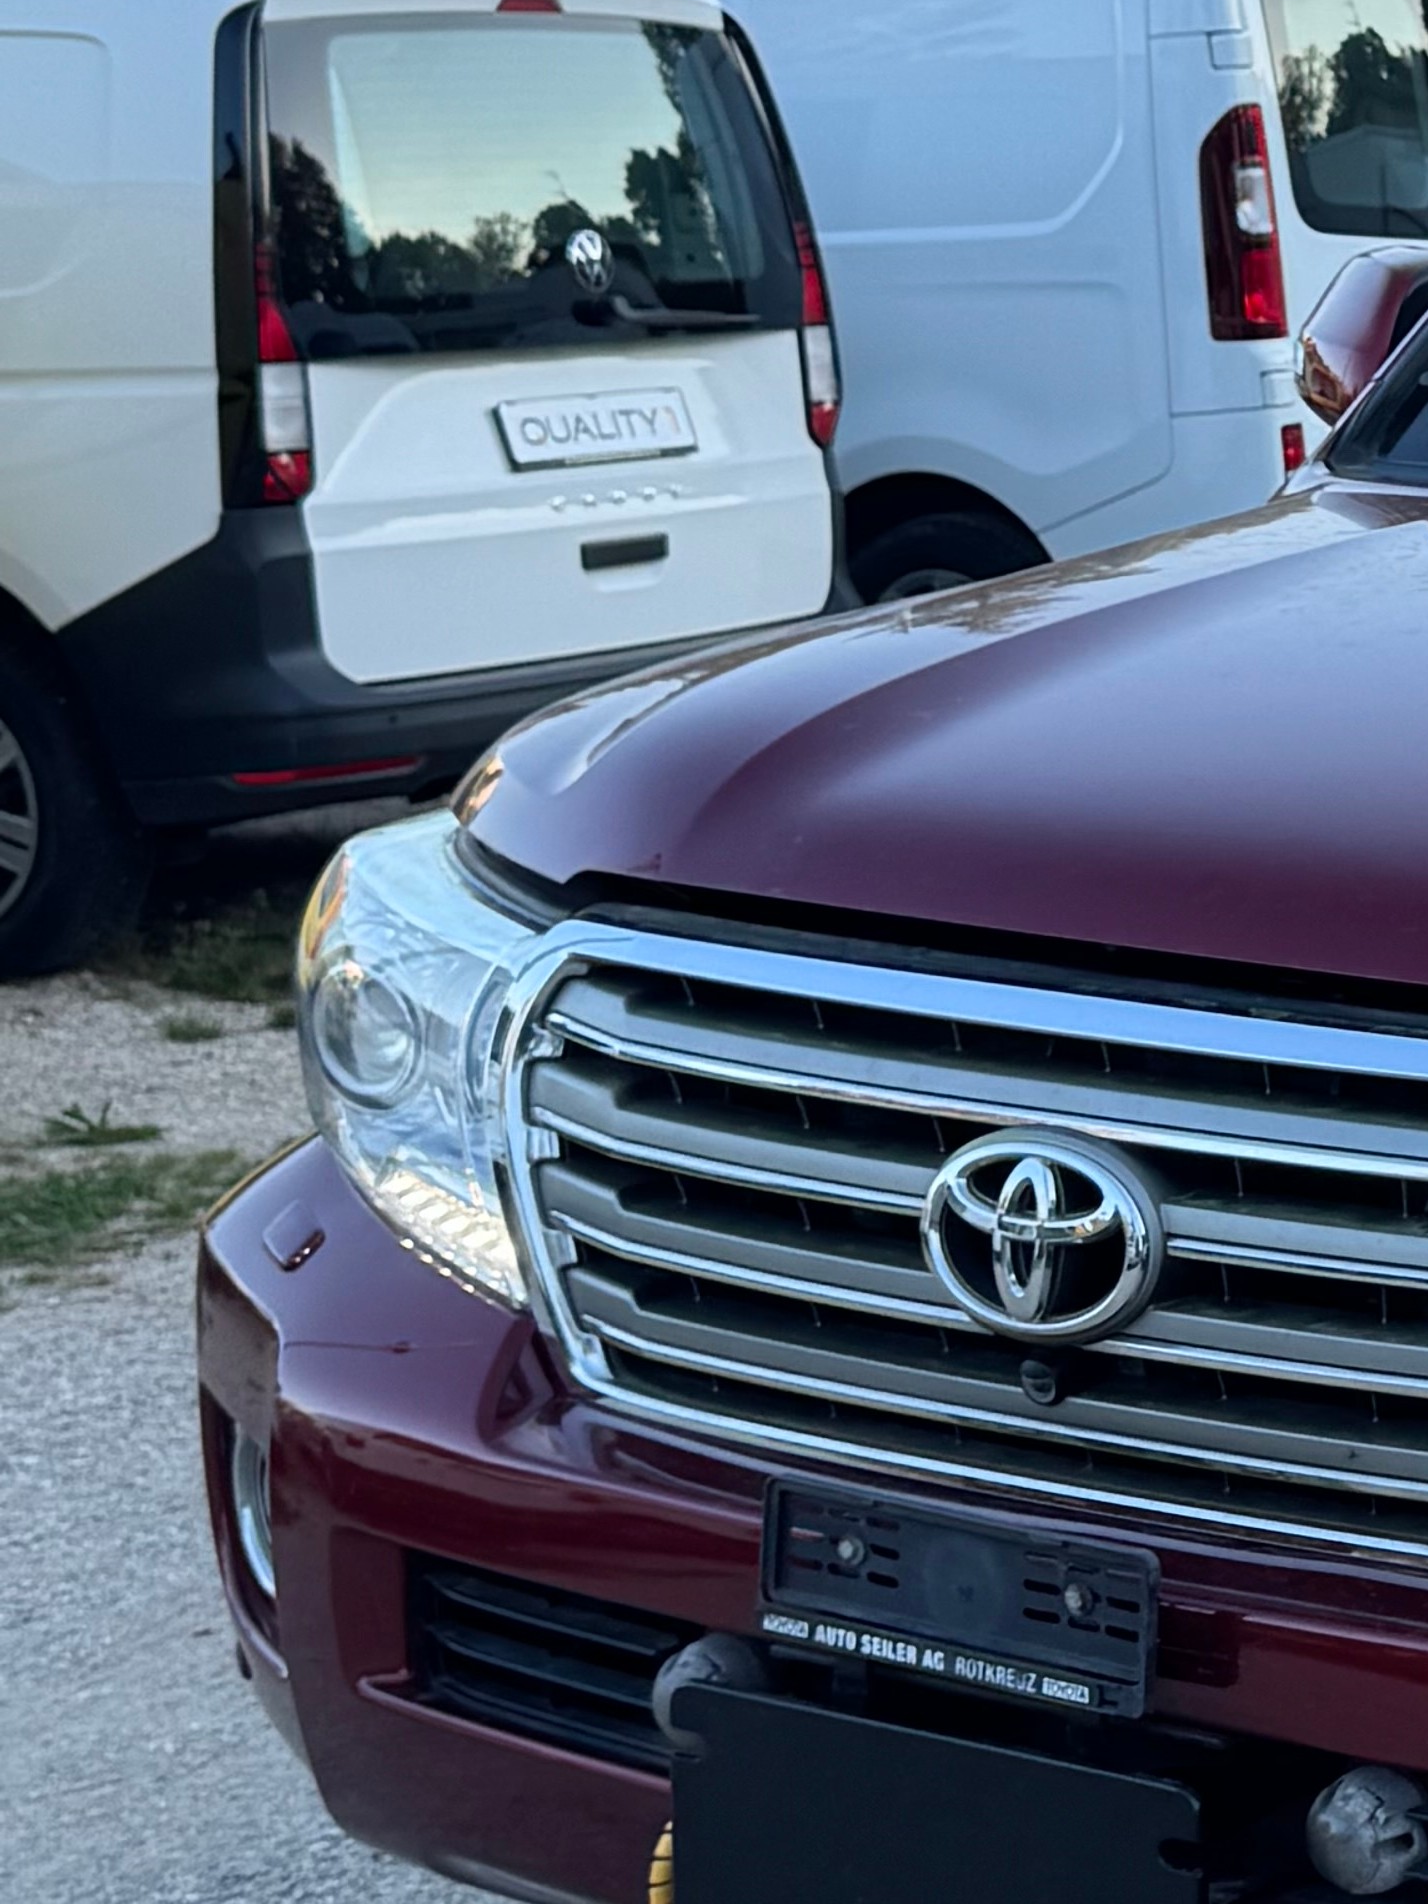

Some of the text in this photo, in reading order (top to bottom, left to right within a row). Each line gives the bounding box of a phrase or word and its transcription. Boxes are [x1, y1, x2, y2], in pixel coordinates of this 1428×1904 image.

[814, 1624, 857, 1651] AUTO
[860, 1633, 917, 1666] SEILER
[921, 1648, 945, 1672] AG
[1041, 1676, 1090, 1705] TOYOTA
